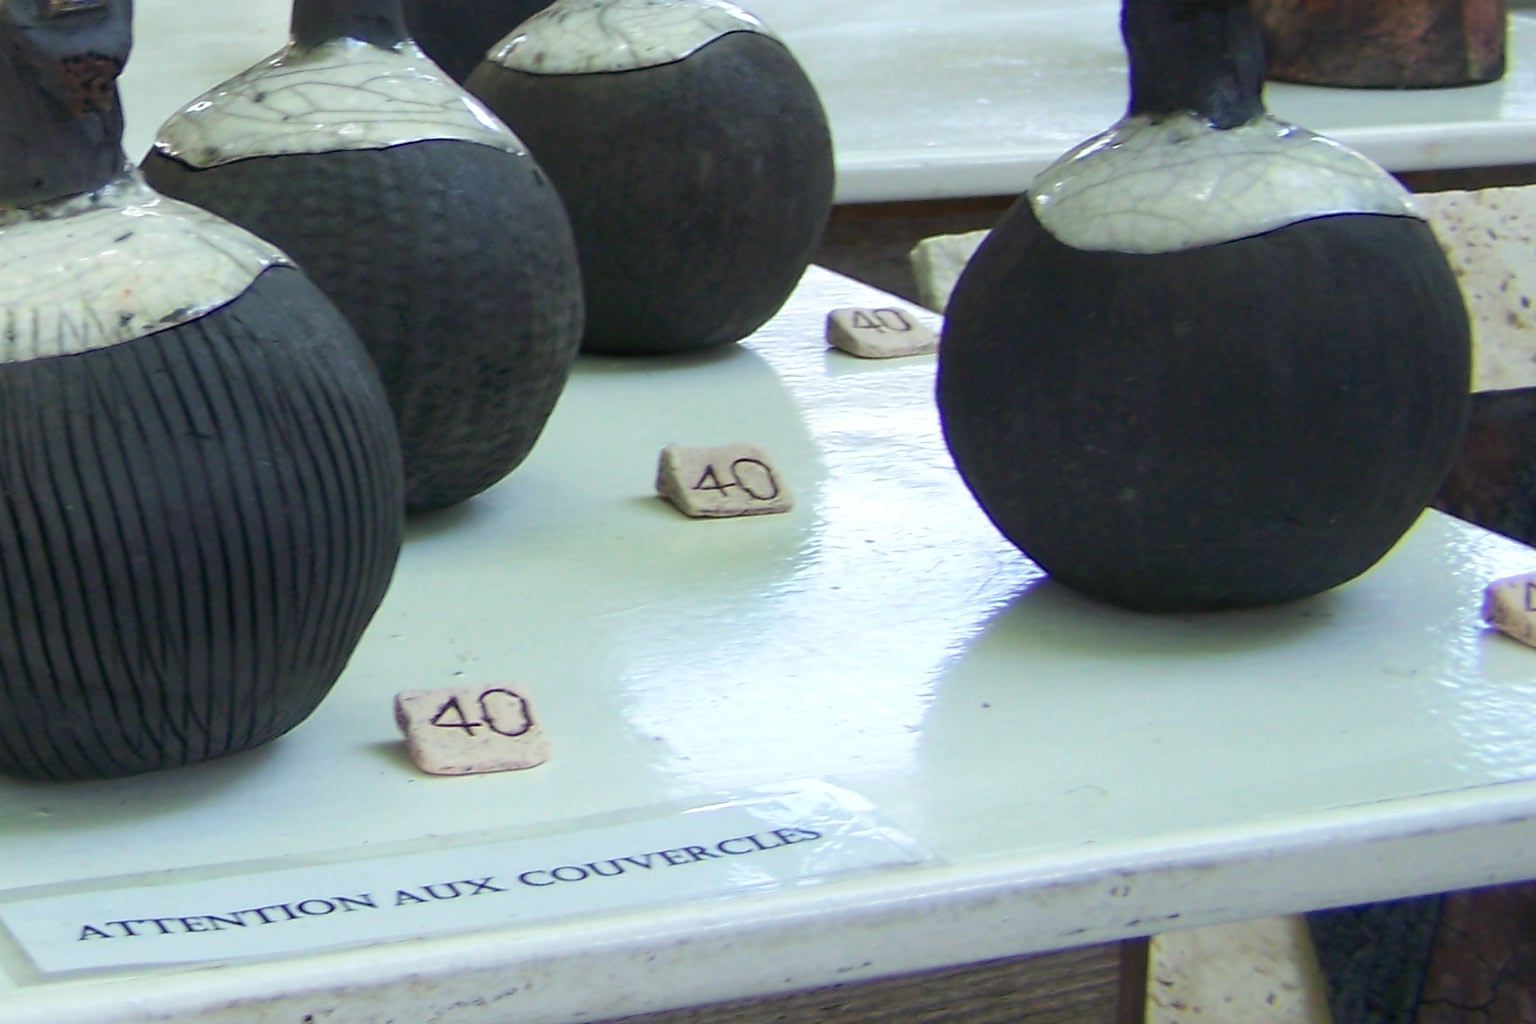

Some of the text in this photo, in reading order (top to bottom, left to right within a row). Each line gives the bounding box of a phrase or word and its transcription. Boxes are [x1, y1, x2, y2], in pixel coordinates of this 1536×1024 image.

[851, 308, 912, 334] 40
[691, 457, 778, 500] 40
[429, 687, 534, 738] 40
[76, 826, 824, 941] ATTENTION AUX COUVERCLES
